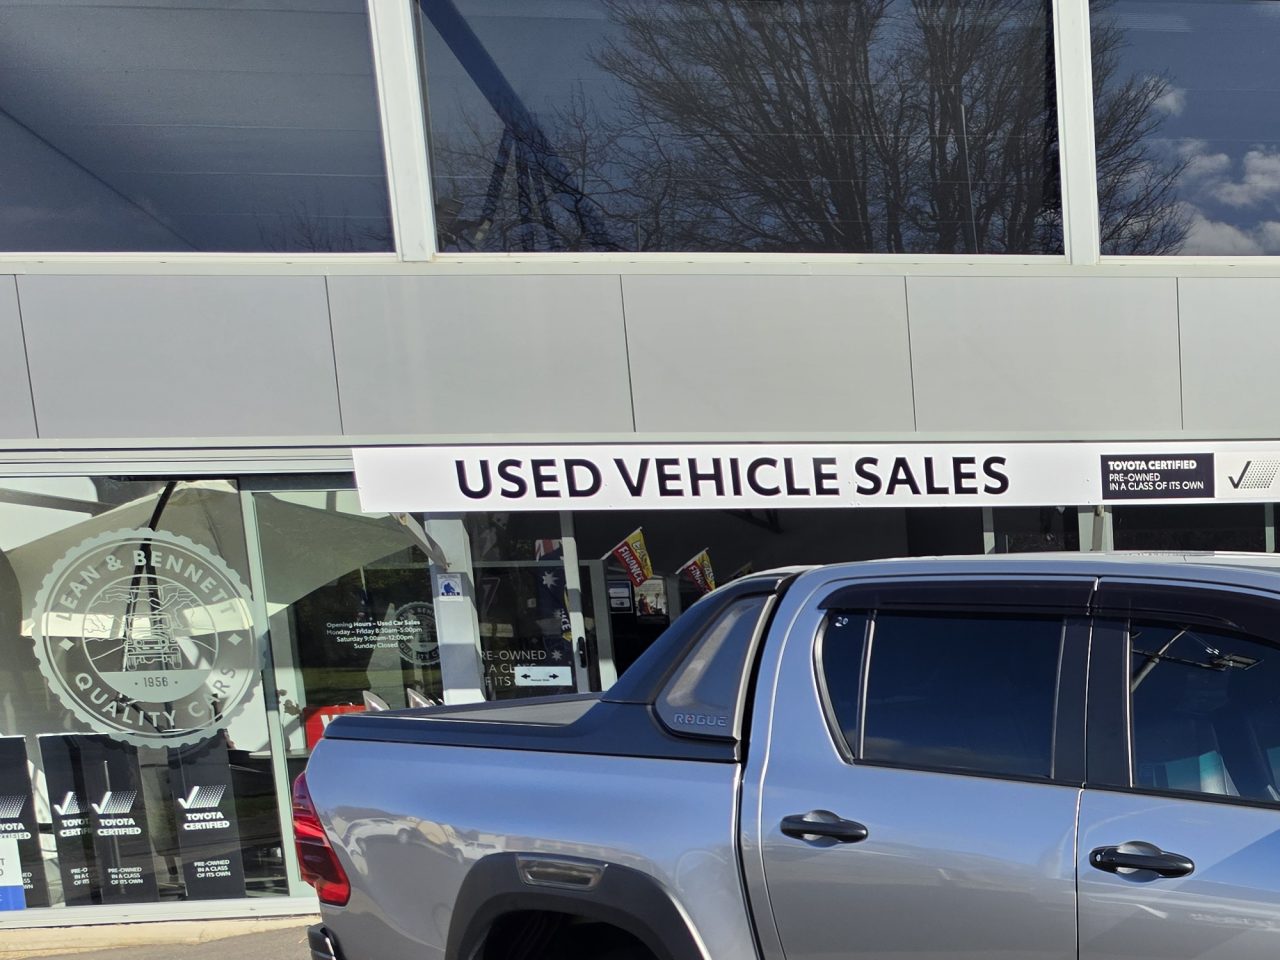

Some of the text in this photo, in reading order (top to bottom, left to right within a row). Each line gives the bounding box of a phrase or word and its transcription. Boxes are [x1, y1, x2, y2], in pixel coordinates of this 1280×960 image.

[1108, 460, 1198, 471] TOYOTA CERTIFIED
[455, 456, 1010, 499] USED VEHICLE SALES
[1109, 472, 1161, 482] PRE-OWNED
[1109, 481, 1204, 491] IN A CLASS OF ITS OWN
[618, 545, 645, 583] FINANCE
[56, 550, 237, 622] LEAN & BENNETT
[481, 650, 547, 660] RE-OWNED
[143, 677, 169, 688] 1956
[494, 676, 512, 686] ITS
[74, 667, 236, 728] QUALITY CARS
[674, 713, 728, 726] ROGUE
[185, 811, 225, 821] TOYOTA
[0, 822, 25, 831] YOTA
[61, 818, 89, 828] TOYOT
[99, 817, 136, 827] TOYOTA
[183, 820, 230, 830] CERTIFIED
[97, 827, 142, 837] CERTIFIED
[193, 859, 230, 867] PRE-OWNED
